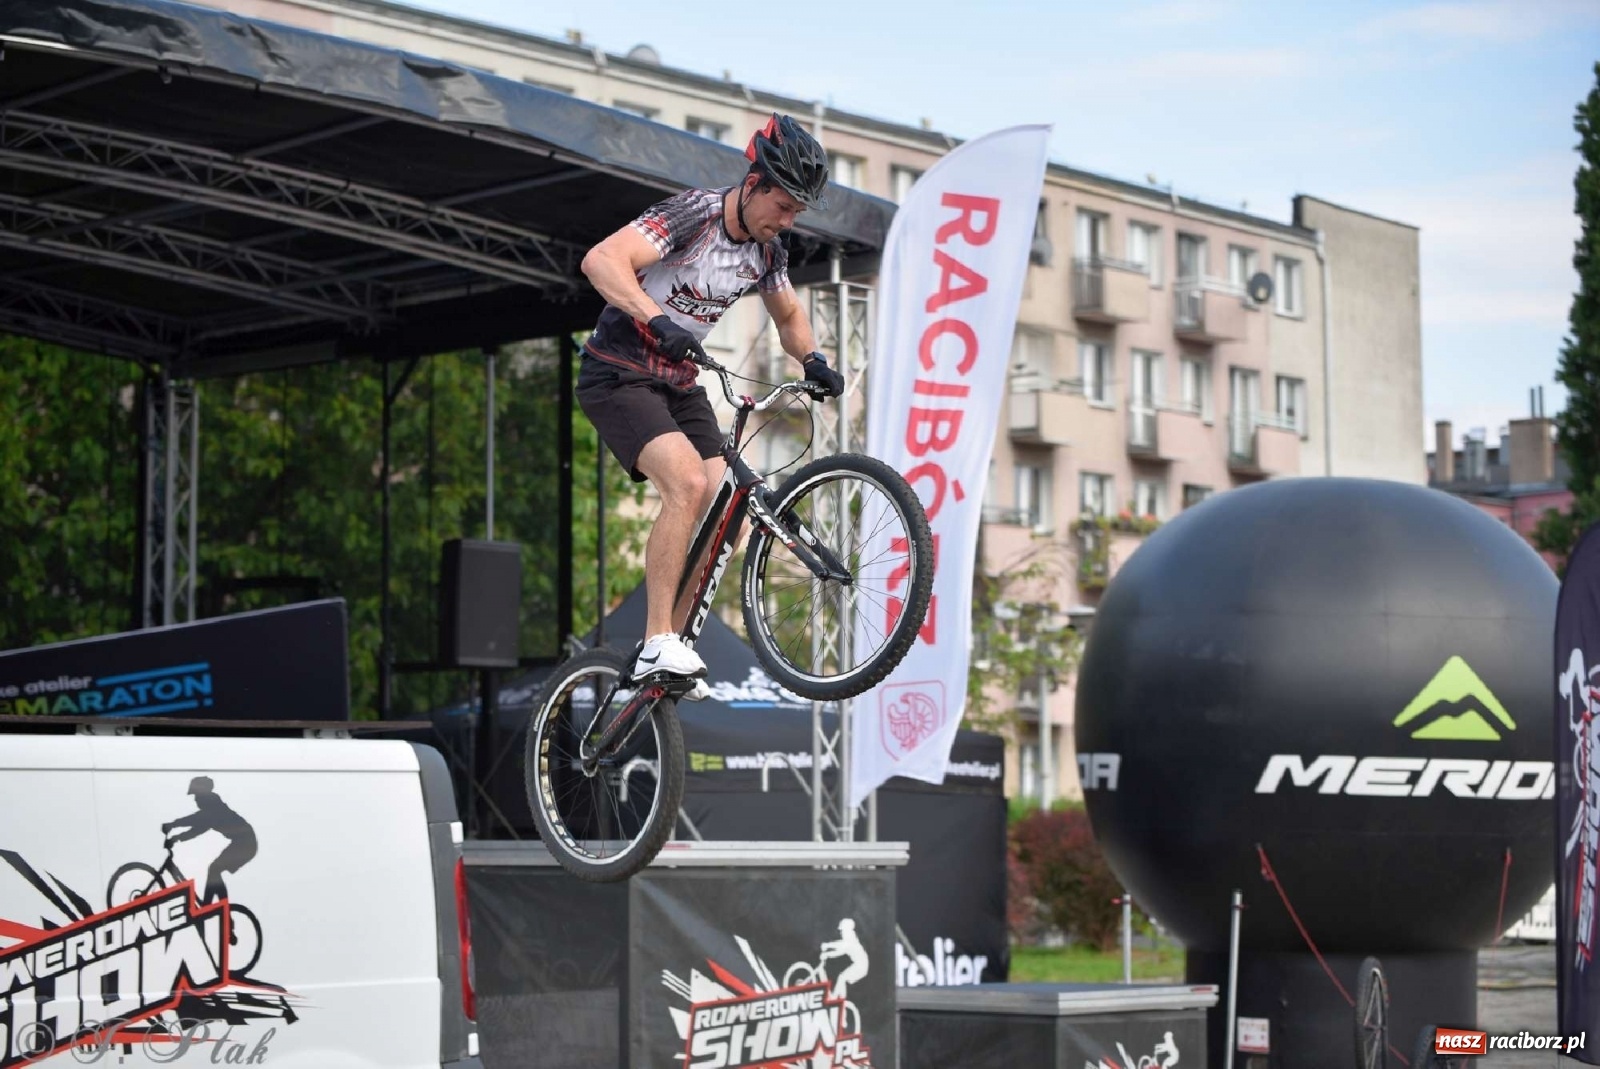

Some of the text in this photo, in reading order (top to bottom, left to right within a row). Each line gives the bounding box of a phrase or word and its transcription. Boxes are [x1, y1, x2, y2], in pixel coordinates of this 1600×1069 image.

[692, 541, 733, 637] CLEAN
[1254, 754, 1555, 800] MERID
[694, 990, 825, 1030] ROWEROWE
[690, 1006, 839, 1069] SHOW
